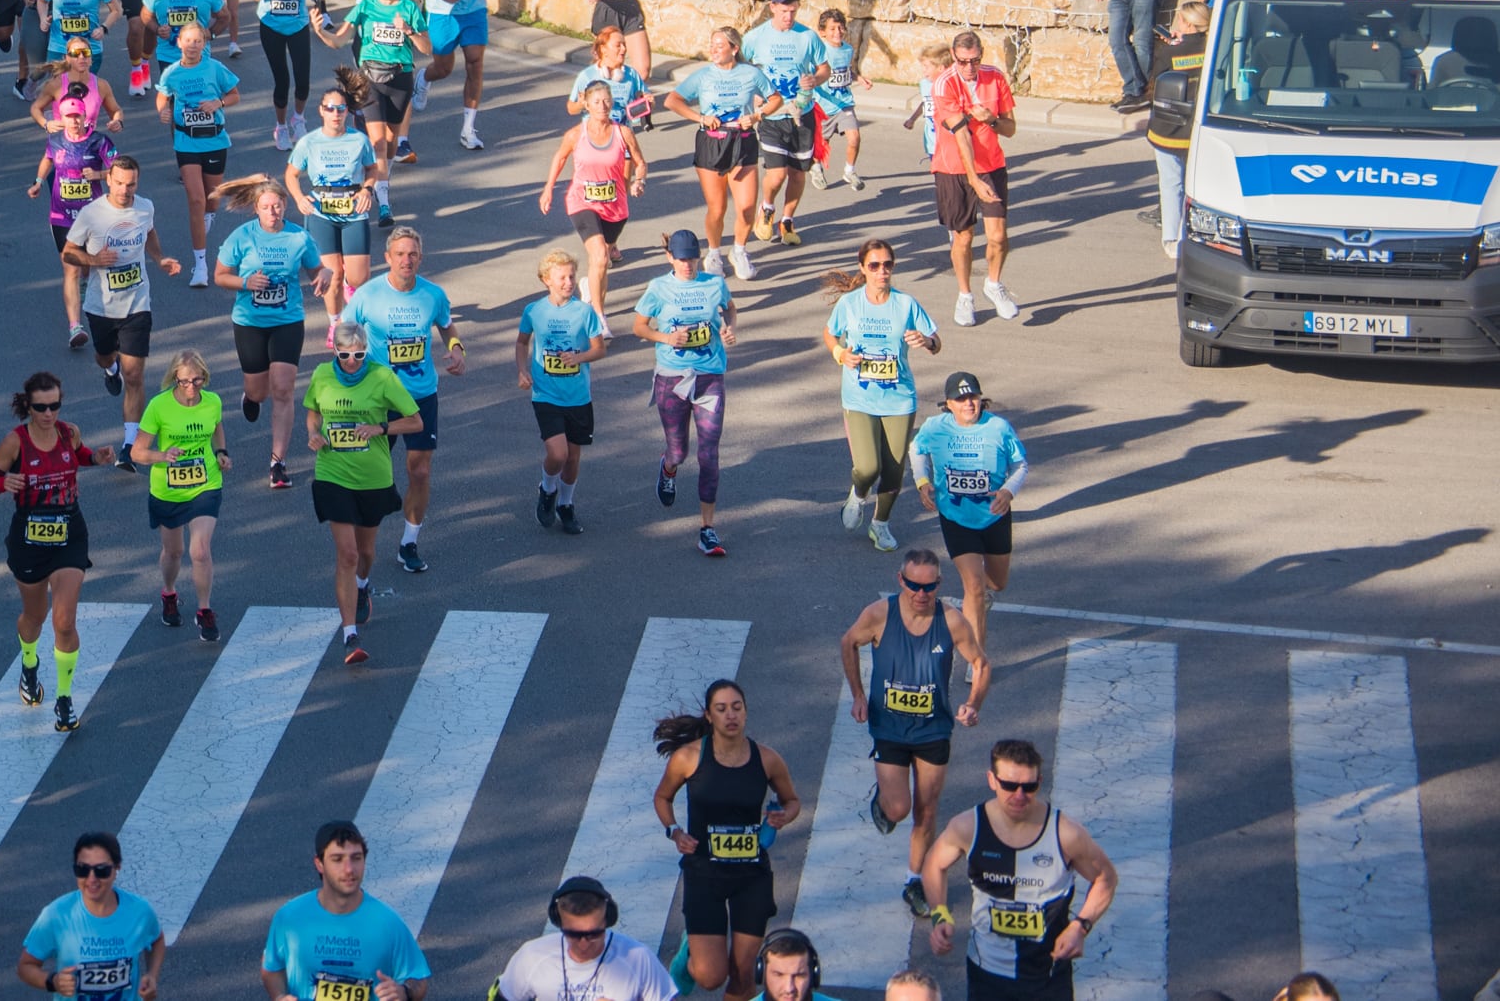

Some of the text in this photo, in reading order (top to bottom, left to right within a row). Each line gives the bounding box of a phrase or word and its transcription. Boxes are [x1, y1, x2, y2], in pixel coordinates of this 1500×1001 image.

[273, 2, 297, 11] 2069
[63, 19, 87, 29] 1198
[170, 13, 195, 22] 1073
[375, 29, 402, 40] 2569
[1335, 167, 1438, 187] vithas
[62, 184, 88, 195] 1345
[587, 186, 614, 197] 1310
[322, 199, 351, 210] 1464
[106, 236, 143, 248] QUIKSILVER
[1325, 247, 1390, 263] MAN
[112, 270, 138, 285] 1032
[256, 288, 285, 300] 2073
[1314, 316, 1399, 334] 6912 MYL
[686, 329, 708, 342] 211
[392, 344, 421, 358] 1277
[863, 361, 894, 375] 1021
[170, 466, 204, 480] 1513
[950, 476, 986, 490] 2639
[30, 524, 64, 537] 1294
[889, 691, 930, 709] 1482
[712, 836, 755, 852] 1448
[982, 871, 1045, 887] PONTYPRIDD
[994, 913, 1040, 930] 1251
[83, 968, 127, 986] 2261
[320, 982, 366, 1001] 1519
